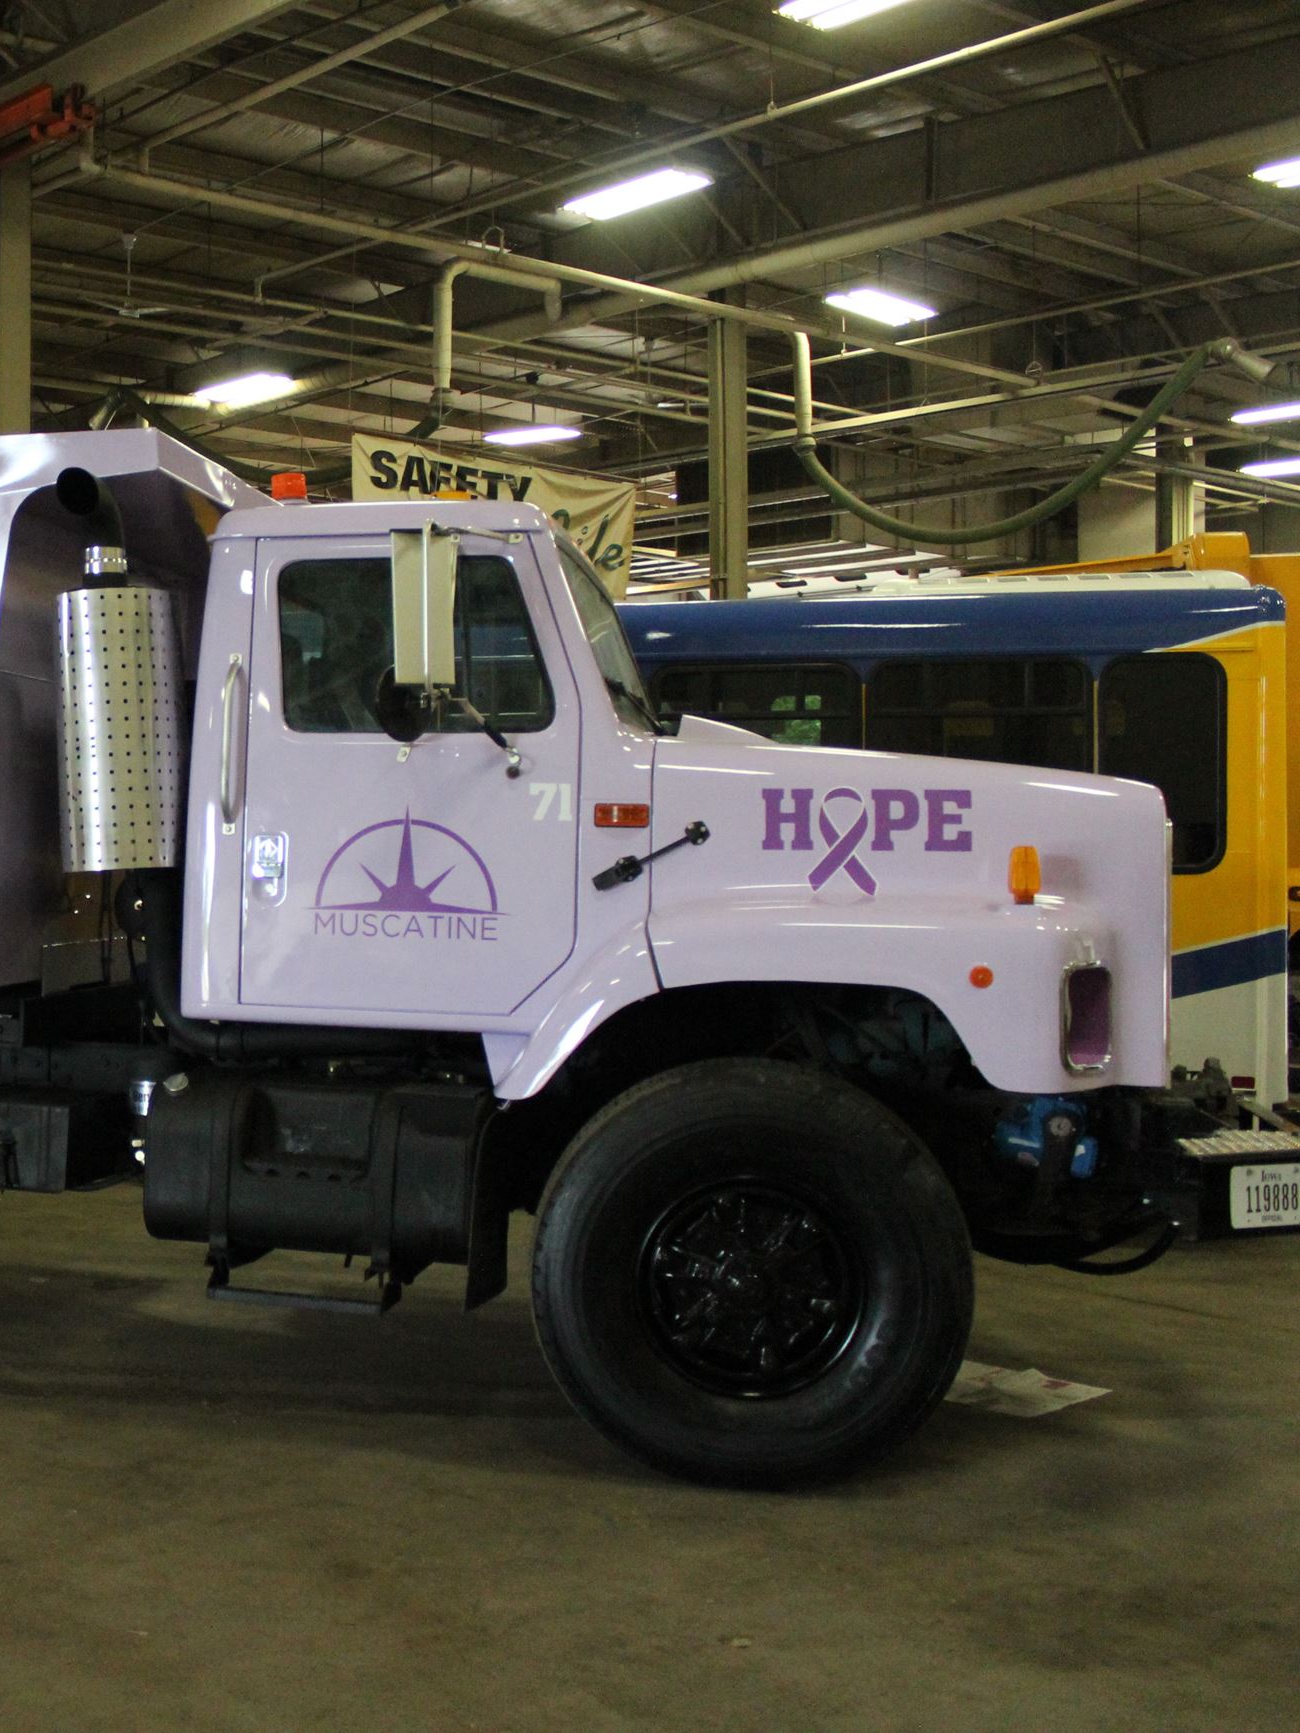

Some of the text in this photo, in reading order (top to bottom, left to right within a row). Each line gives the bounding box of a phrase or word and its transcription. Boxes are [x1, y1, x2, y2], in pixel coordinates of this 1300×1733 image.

[369, 449, 533, 502] SAFETY
[528, 782, 573, 822] 71
[761, 787, 973, 895] HOPE
[313, 912, 499, 941] MUSCATINE
[1246, 1182, 1299, 1213] 119888
